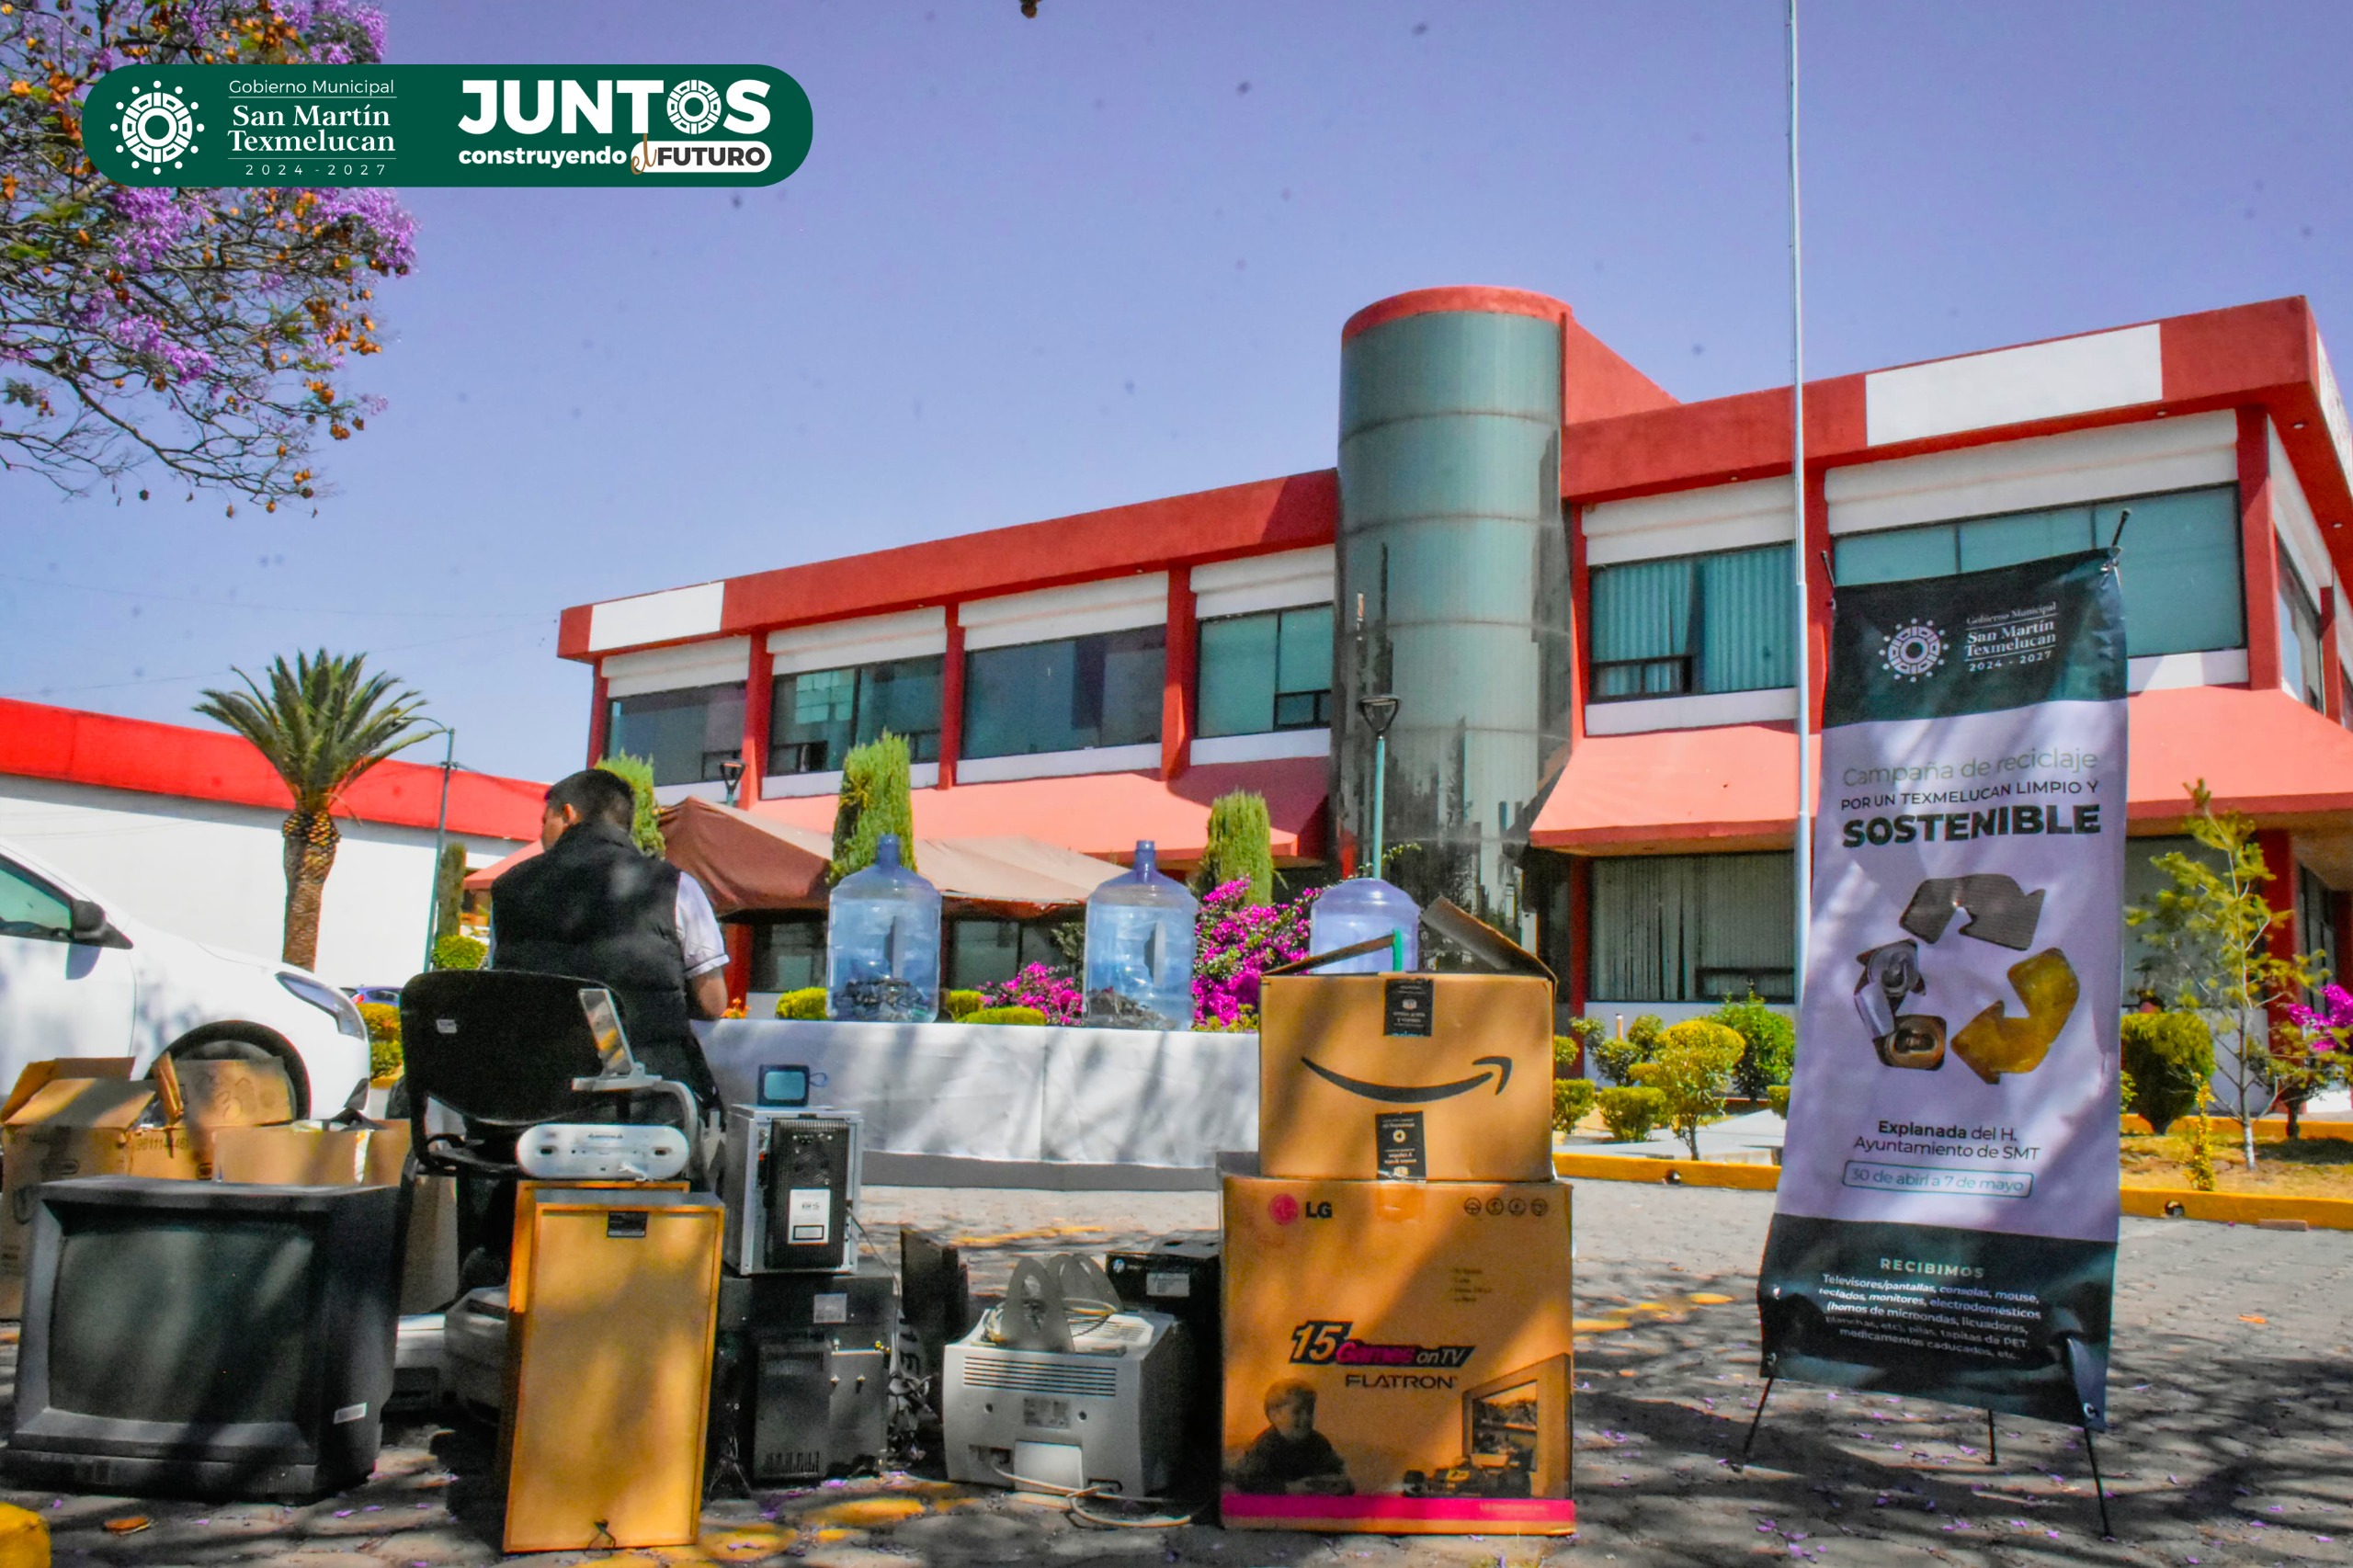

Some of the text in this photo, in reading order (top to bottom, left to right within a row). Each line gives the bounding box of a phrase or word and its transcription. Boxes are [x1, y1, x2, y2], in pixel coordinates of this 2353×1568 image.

[1967, 619, 2055, 644] San Martín
[1964, 633, 2057, 657] Texmelucan
[1969, 659, 2003, 672] 2024
[2019, 650, 2052, 665] 2027
[1843, 747, 2098, 787] Campaña de reciclaje
[1841, 779, 2099, 812] POR UN TEXMELUCAN LIMPIO Y
[1842, 803, 2101, 849] SOSTENIBLE
[1878, 1119, 2018, 1142] Explanada del H.
[1854, 1135, 2041, 1161] Ayuntamiento de SMT
[1851, 1167, 1870, 1182] 30
[1872, 1170, 1893, 1185] de
[1931, 1177, 1941, 1187] a
[1944, 1176, 1954, 1187] 7
[1956, 1176, 1976, 1189] de
[1979, 1179, 2024, 1193] mayo
[1306, 1201, 1332, 1219] LG
[1880, 1257, 1984, 1278] RECIBIMOS
[1870, 1306, 1885, 1316] de
[1293, 1324, 1342, 1361] 15
